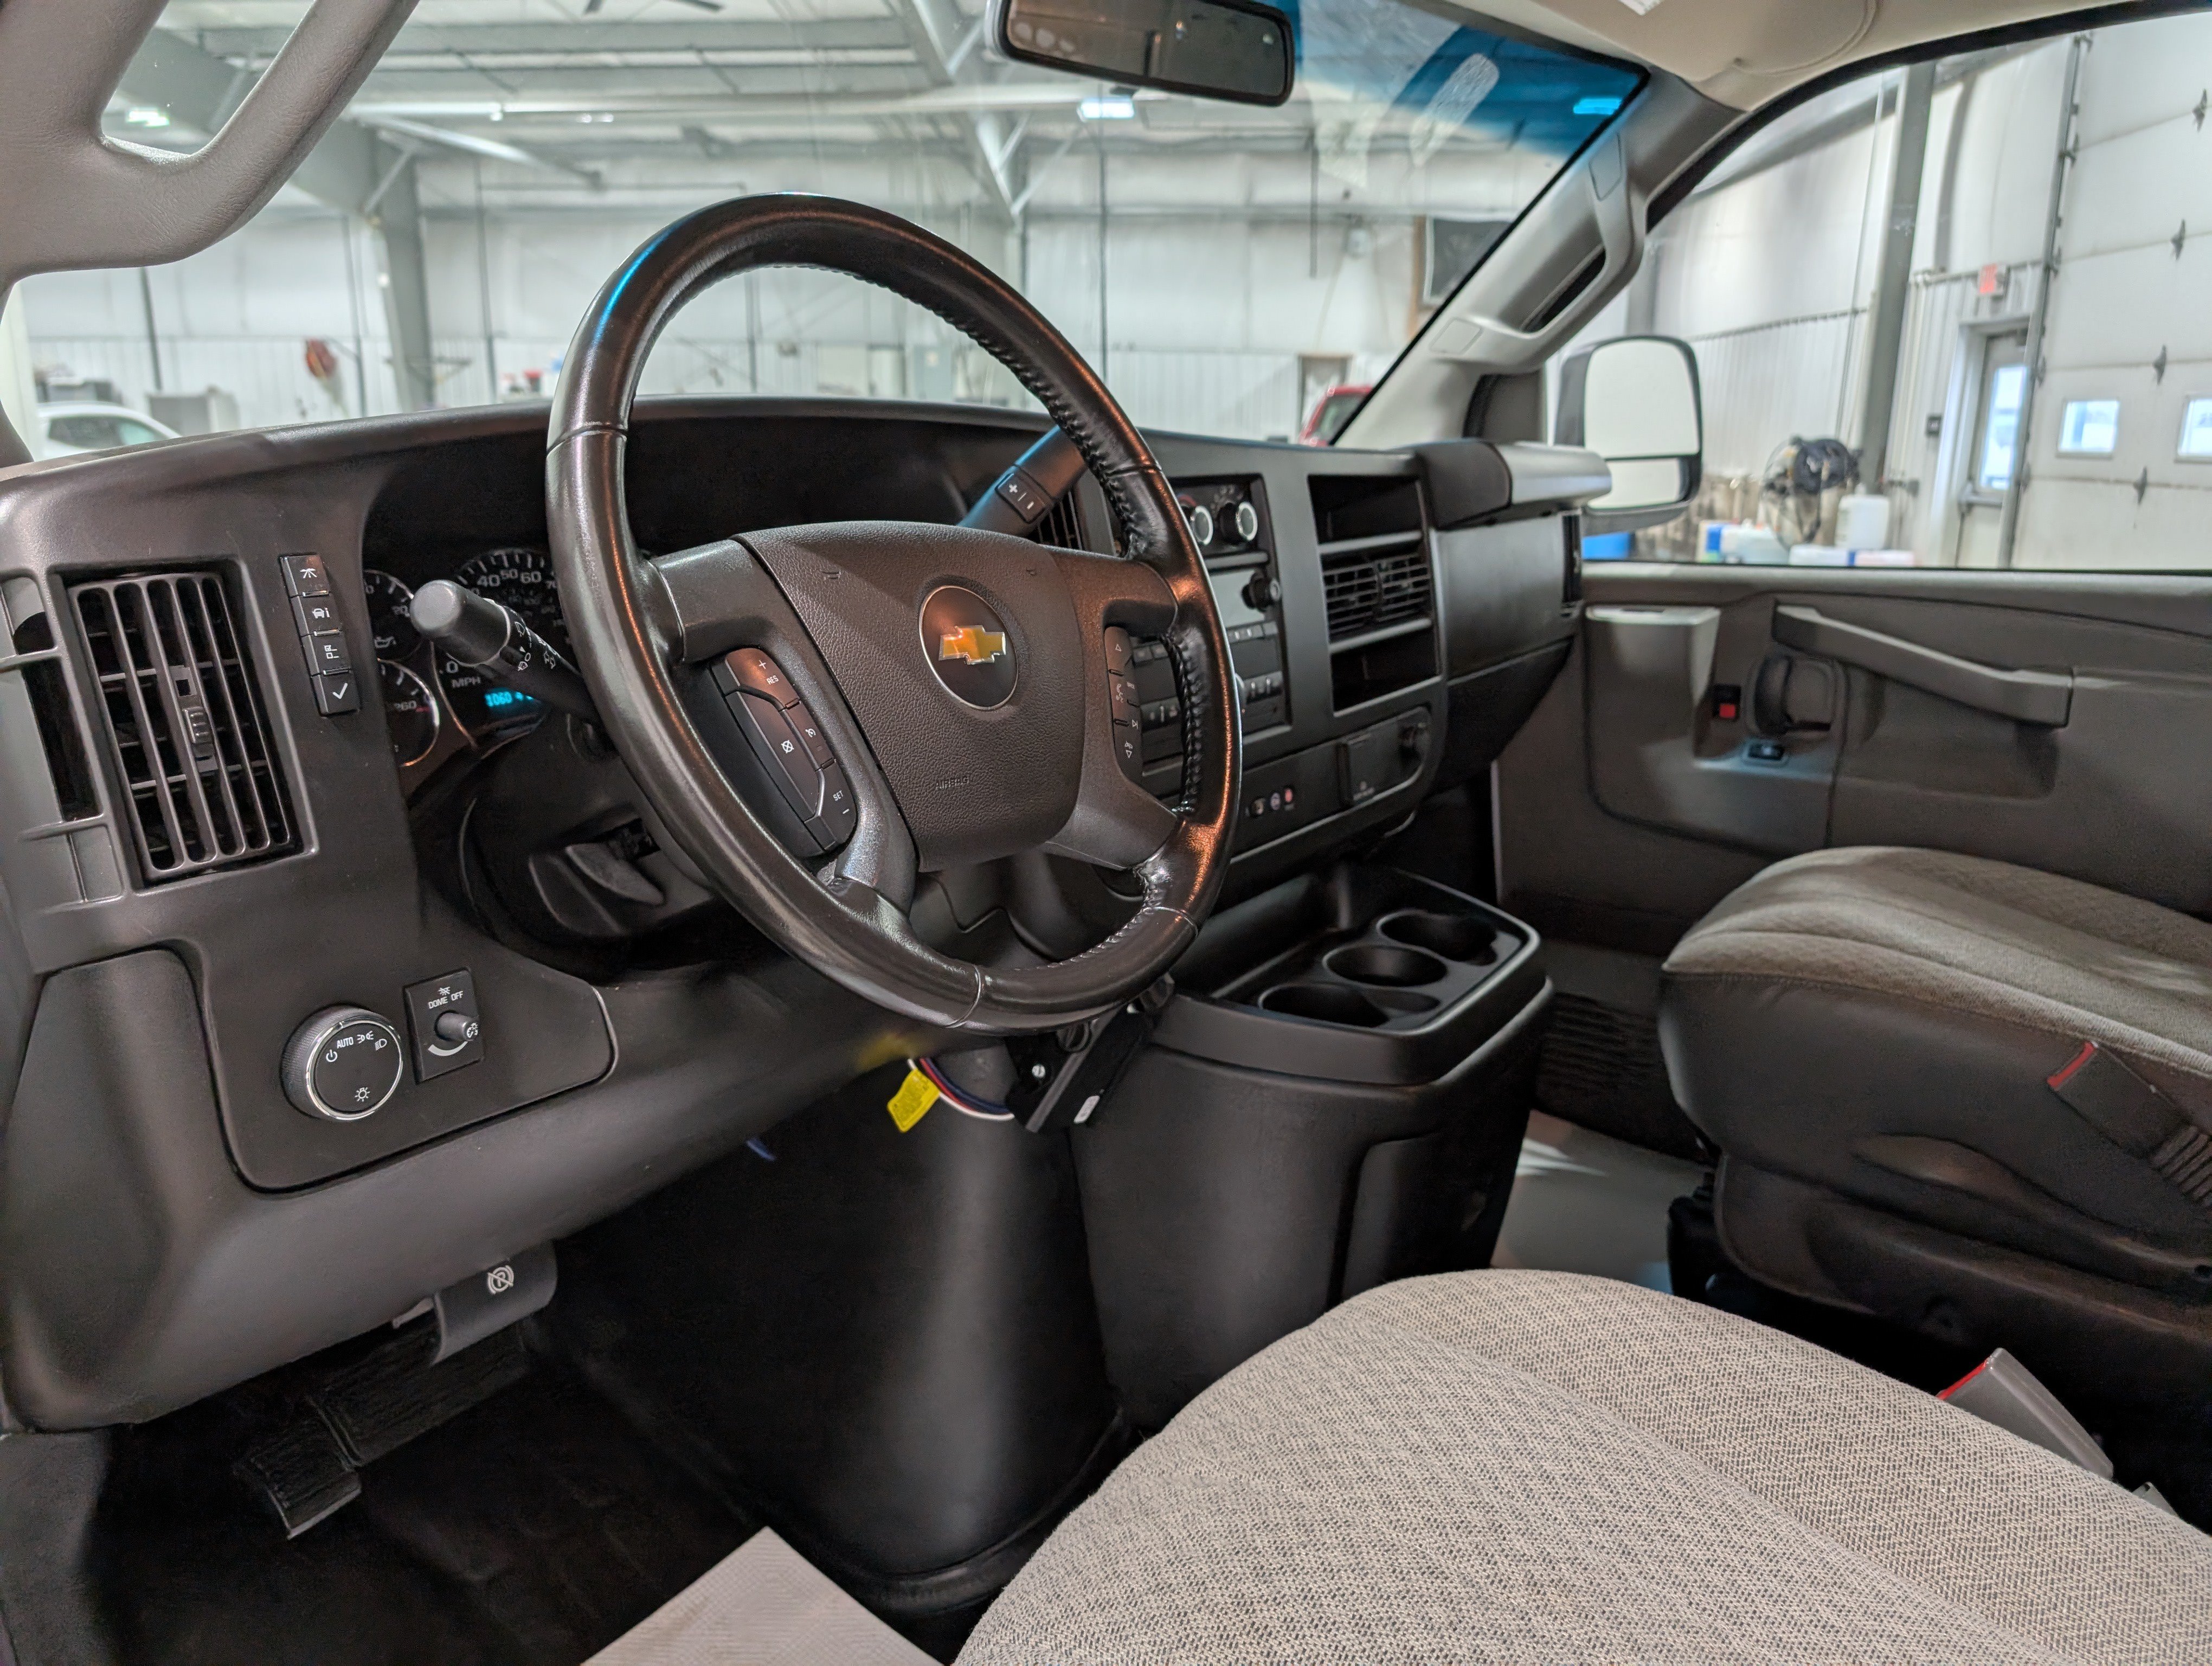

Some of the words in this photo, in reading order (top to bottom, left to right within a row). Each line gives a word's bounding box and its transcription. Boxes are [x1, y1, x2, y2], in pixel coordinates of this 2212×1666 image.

[477, 575, 501, 587] 40
[520, 571, 542, 584] 60
[446, 661, 459, 674] 0
[452, 676, 481, 689] MPH
[766, 675, 779, 685] RES
[935, 777, 969, 791] AIRBAG
[833, 790, 844, 801] SET
[428, 996, 448, 1009] DOME
[451, 990, 464, 1001] OFF
[337, 1036, 354, 1049] AUTO
